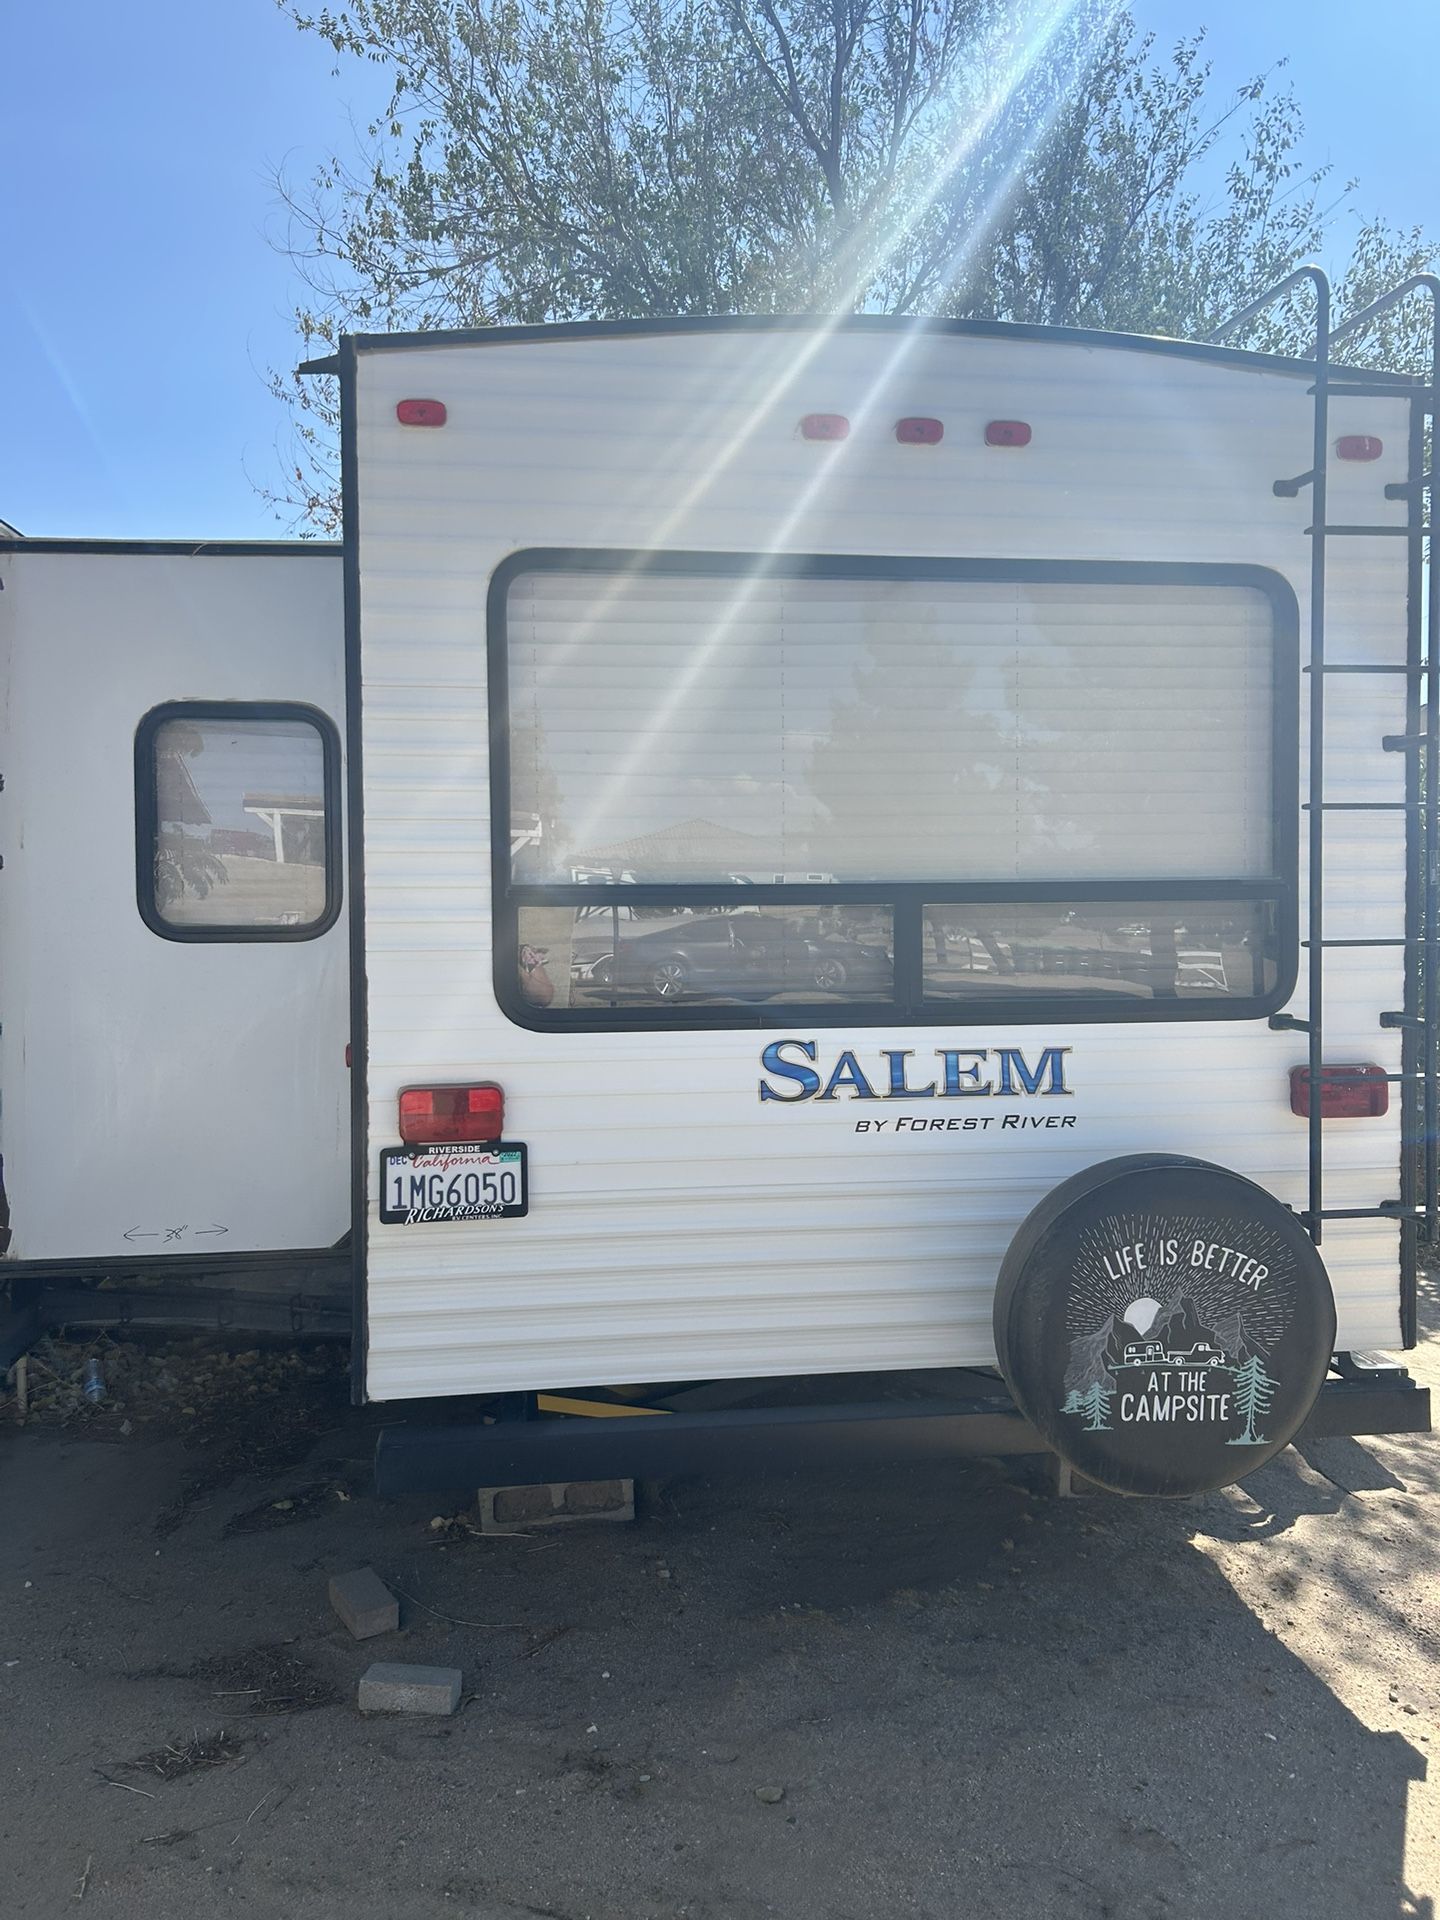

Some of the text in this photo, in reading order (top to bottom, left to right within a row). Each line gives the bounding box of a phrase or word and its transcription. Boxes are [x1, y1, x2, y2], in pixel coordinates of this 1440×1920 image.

[758, 1040, 1076, 1103] SALEM
[855, 1115, 1078, 1133] BY FOREST RIVER
[428, 1145, 481, 1154] RIVERSIDE
[389, 1156, 408, 1166] DEC
[412, 1153, 500, 1172] California
[392, 1171, 516, 1209] 1MG6050
[1103, 1239, 1269, 1291] LIFE IS BETTER
[1147, 1370, 1207, 1392] AT THE
[1120, 1393, 1230, 1422] CAMPSITE
